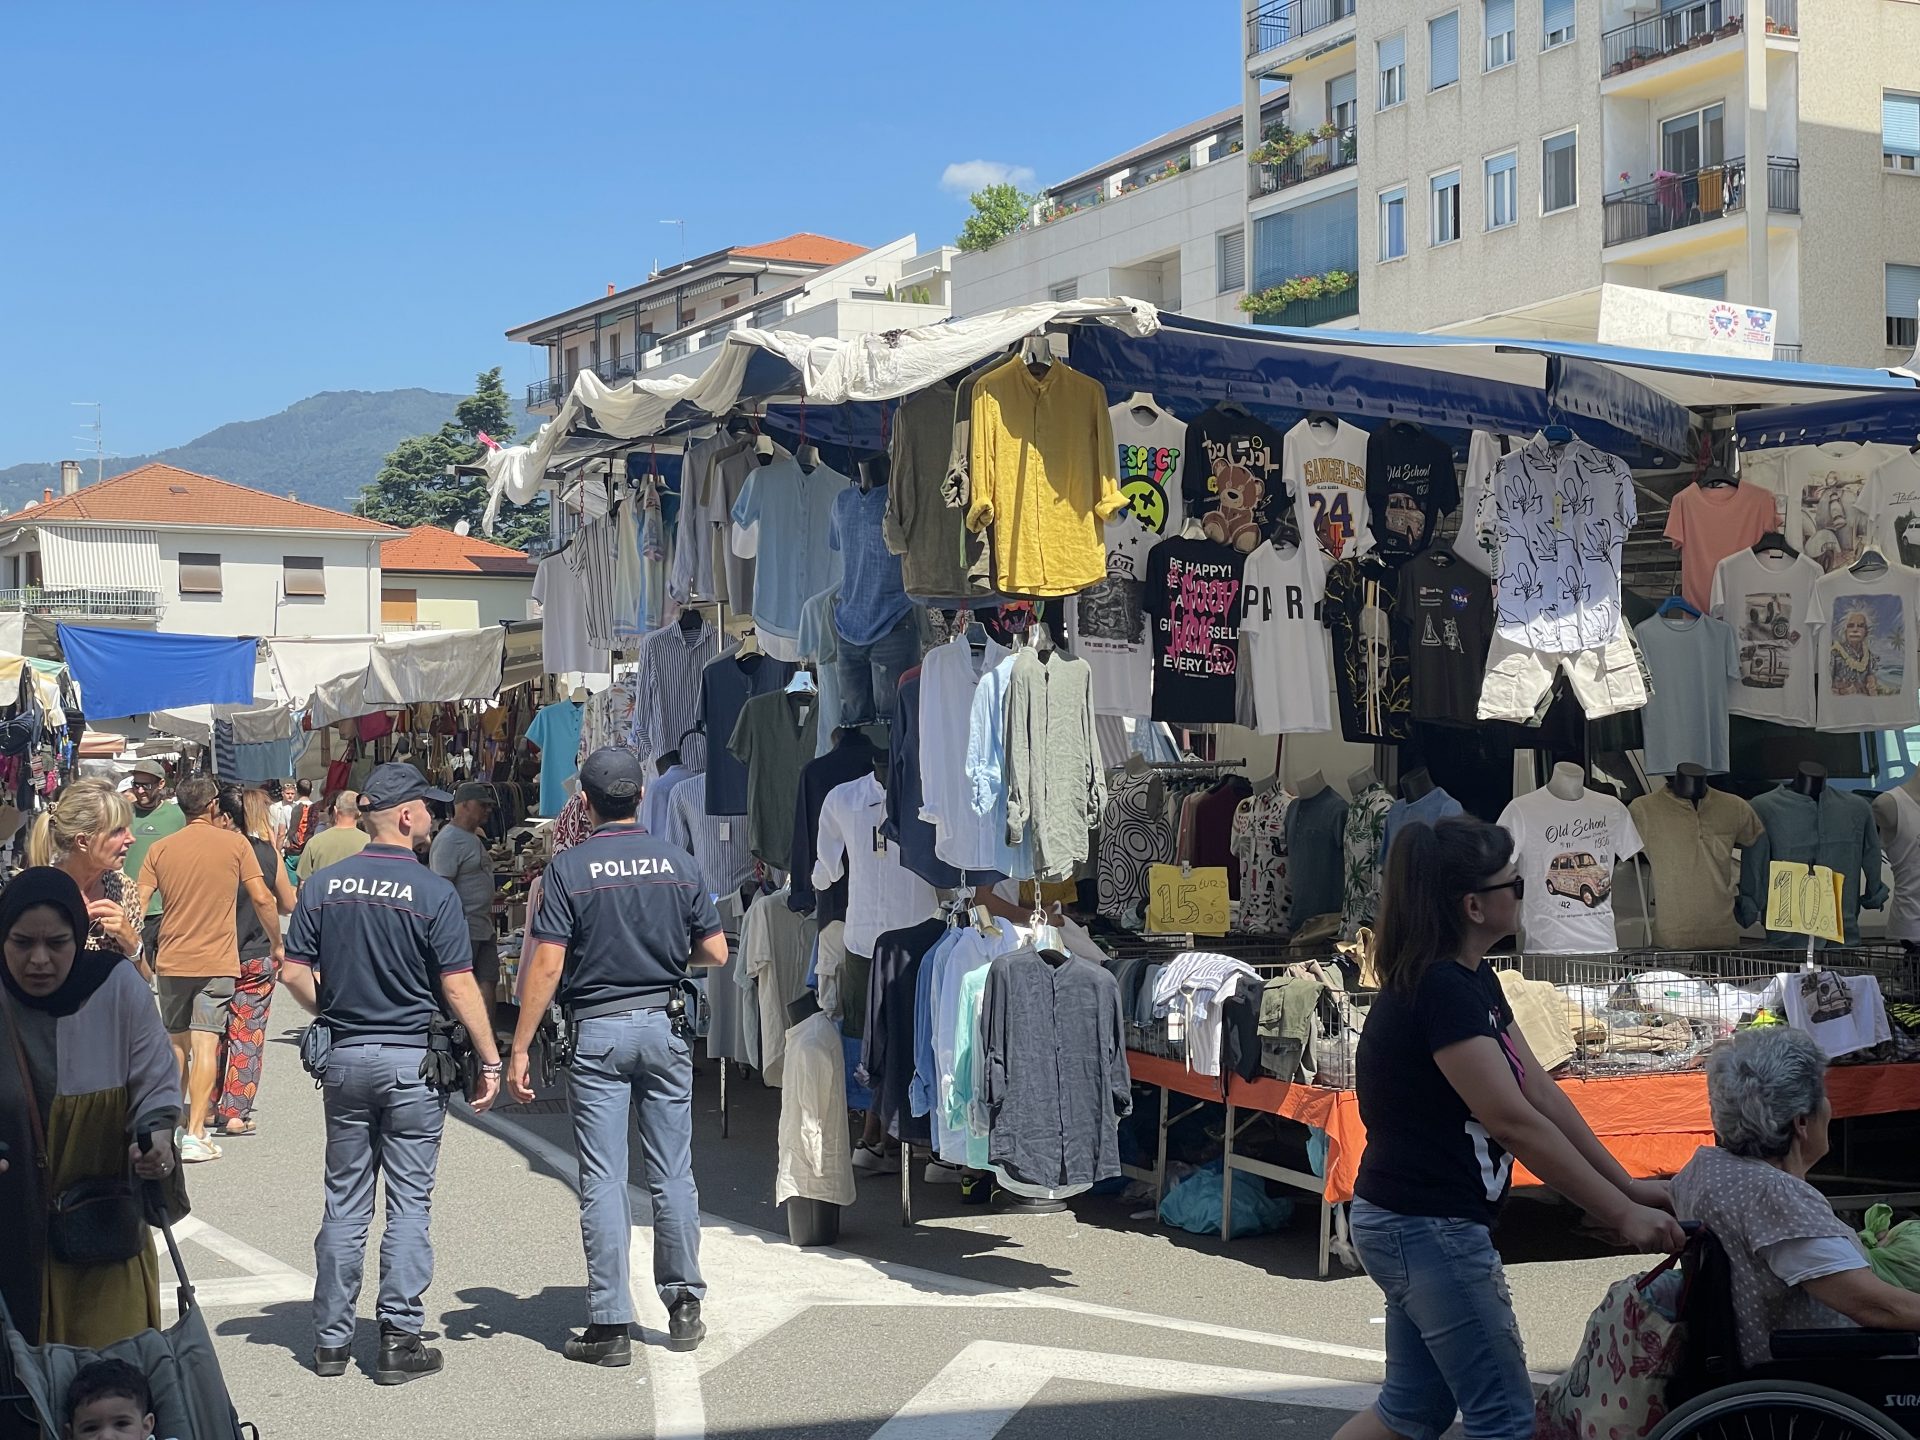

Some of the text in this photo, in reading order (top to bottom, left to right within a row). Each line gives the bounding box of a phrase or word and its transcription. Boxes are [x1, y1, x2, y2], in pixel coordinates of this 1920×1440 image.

[1402, 463, 1432, 481] School
[1308, 492, 1355, 538] 24
[1185, 561, 1232, 578] HAPPY!
[1163, 654, 1203, 672] EVERY
[1545, 825, 1569, 843] Old
[1571, 815, 1607, 838] School
[590, 858, 674, 879] POLIZIA
[327, 877, 413, 902] POLIZIA
